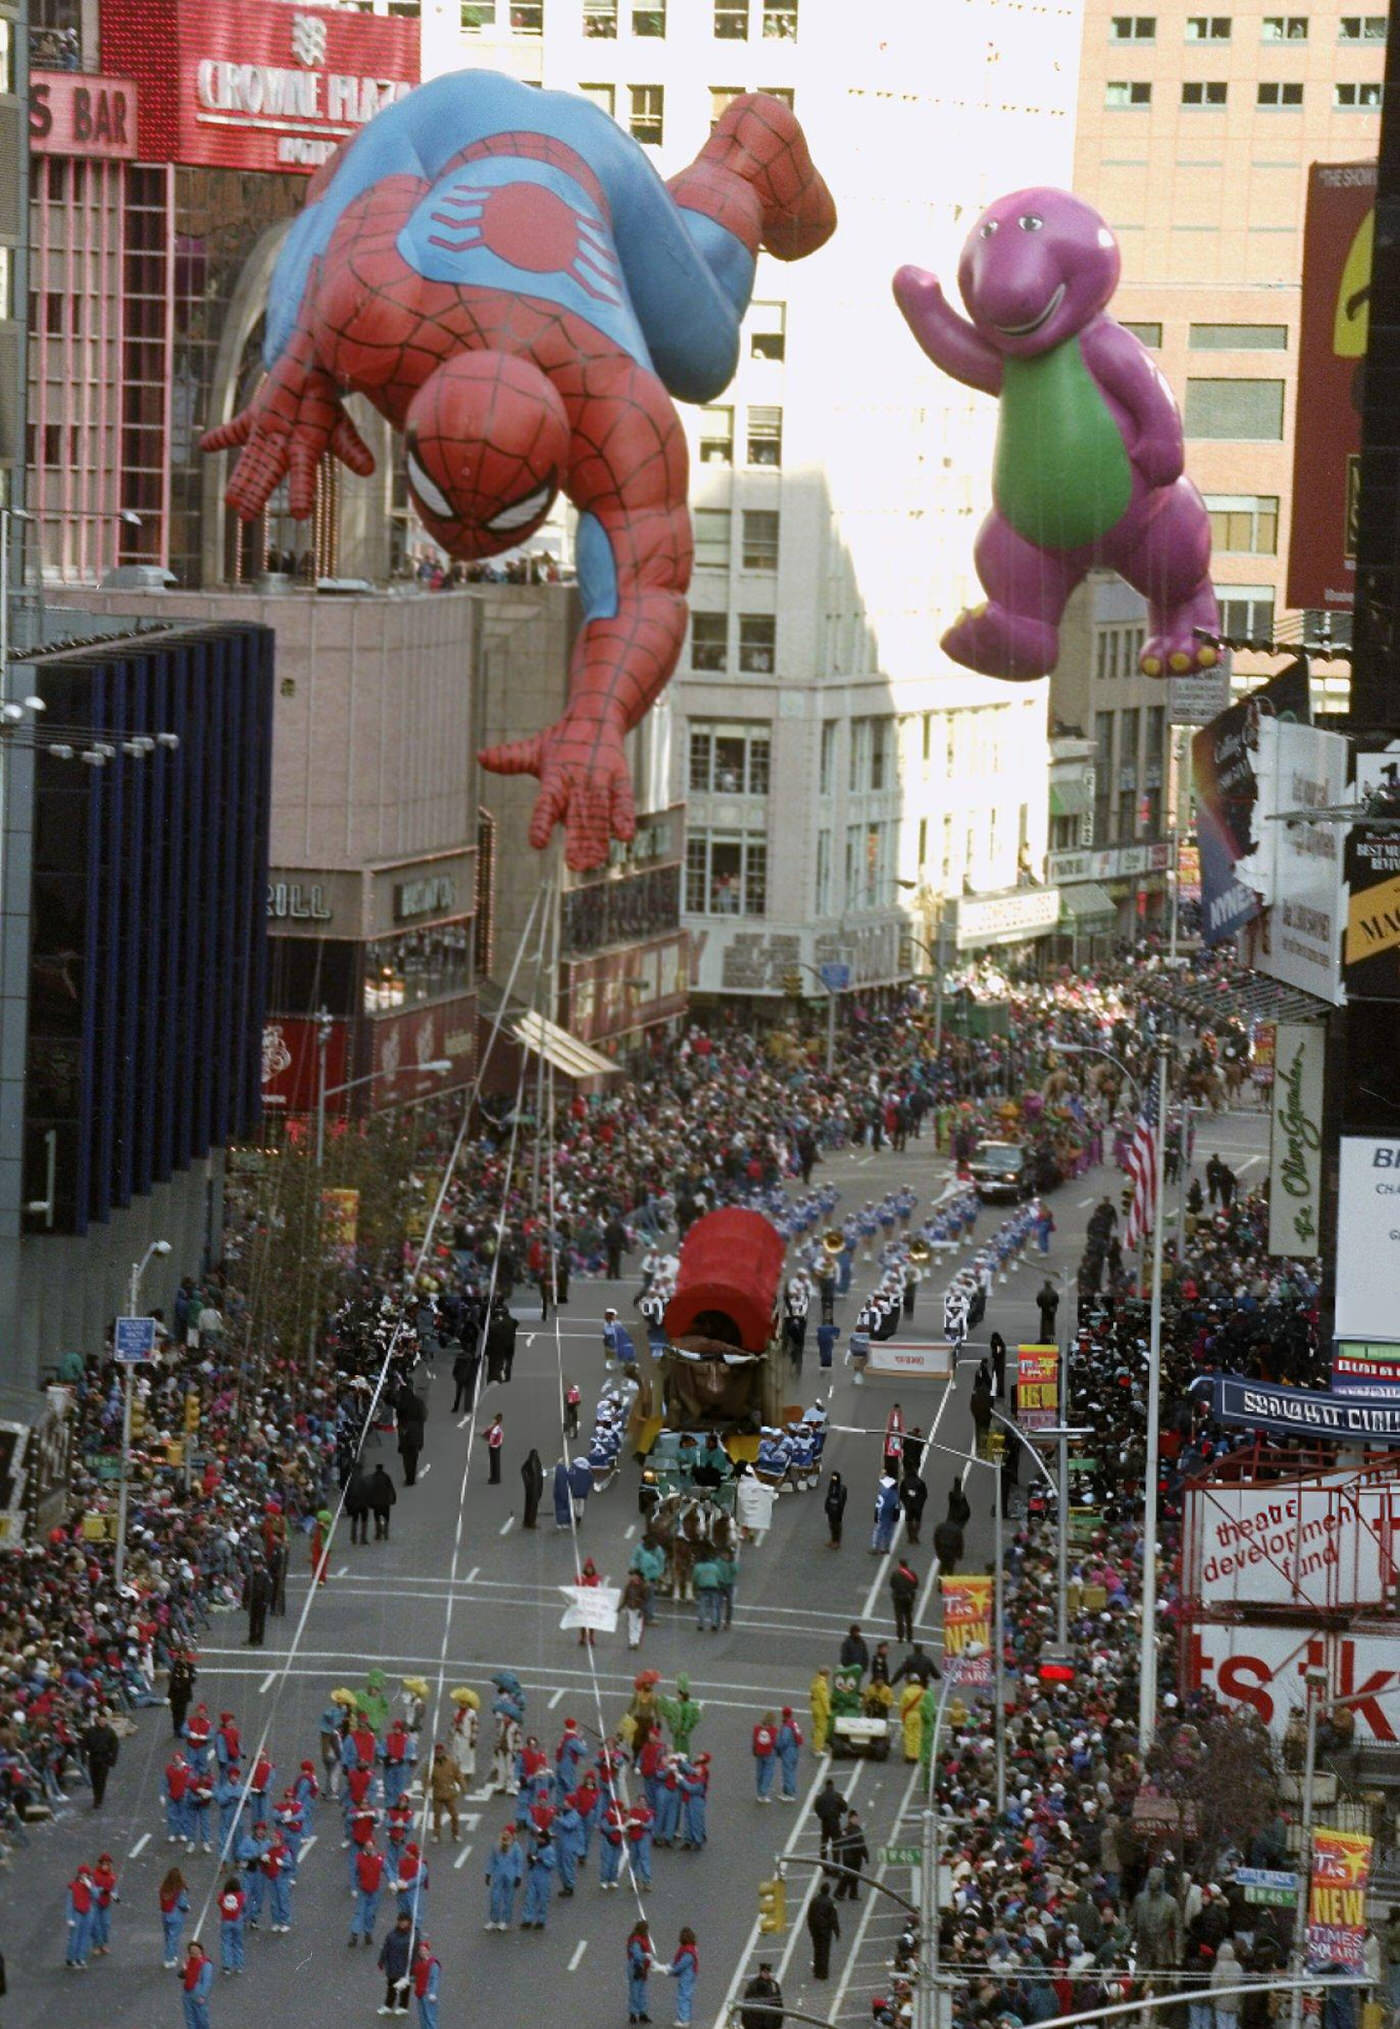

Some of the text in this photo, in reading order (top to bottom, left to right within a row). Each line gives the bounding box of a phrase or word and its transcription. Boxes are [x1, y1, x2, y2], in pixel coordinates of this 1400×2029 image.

[73, 86, 128, 144] BAR
[1314, 1887, 1365, 1926] NEW
[1309, 1925, 1363, 1948] TIMES
[1309, 1942, 1362, 1961] SQUARE
